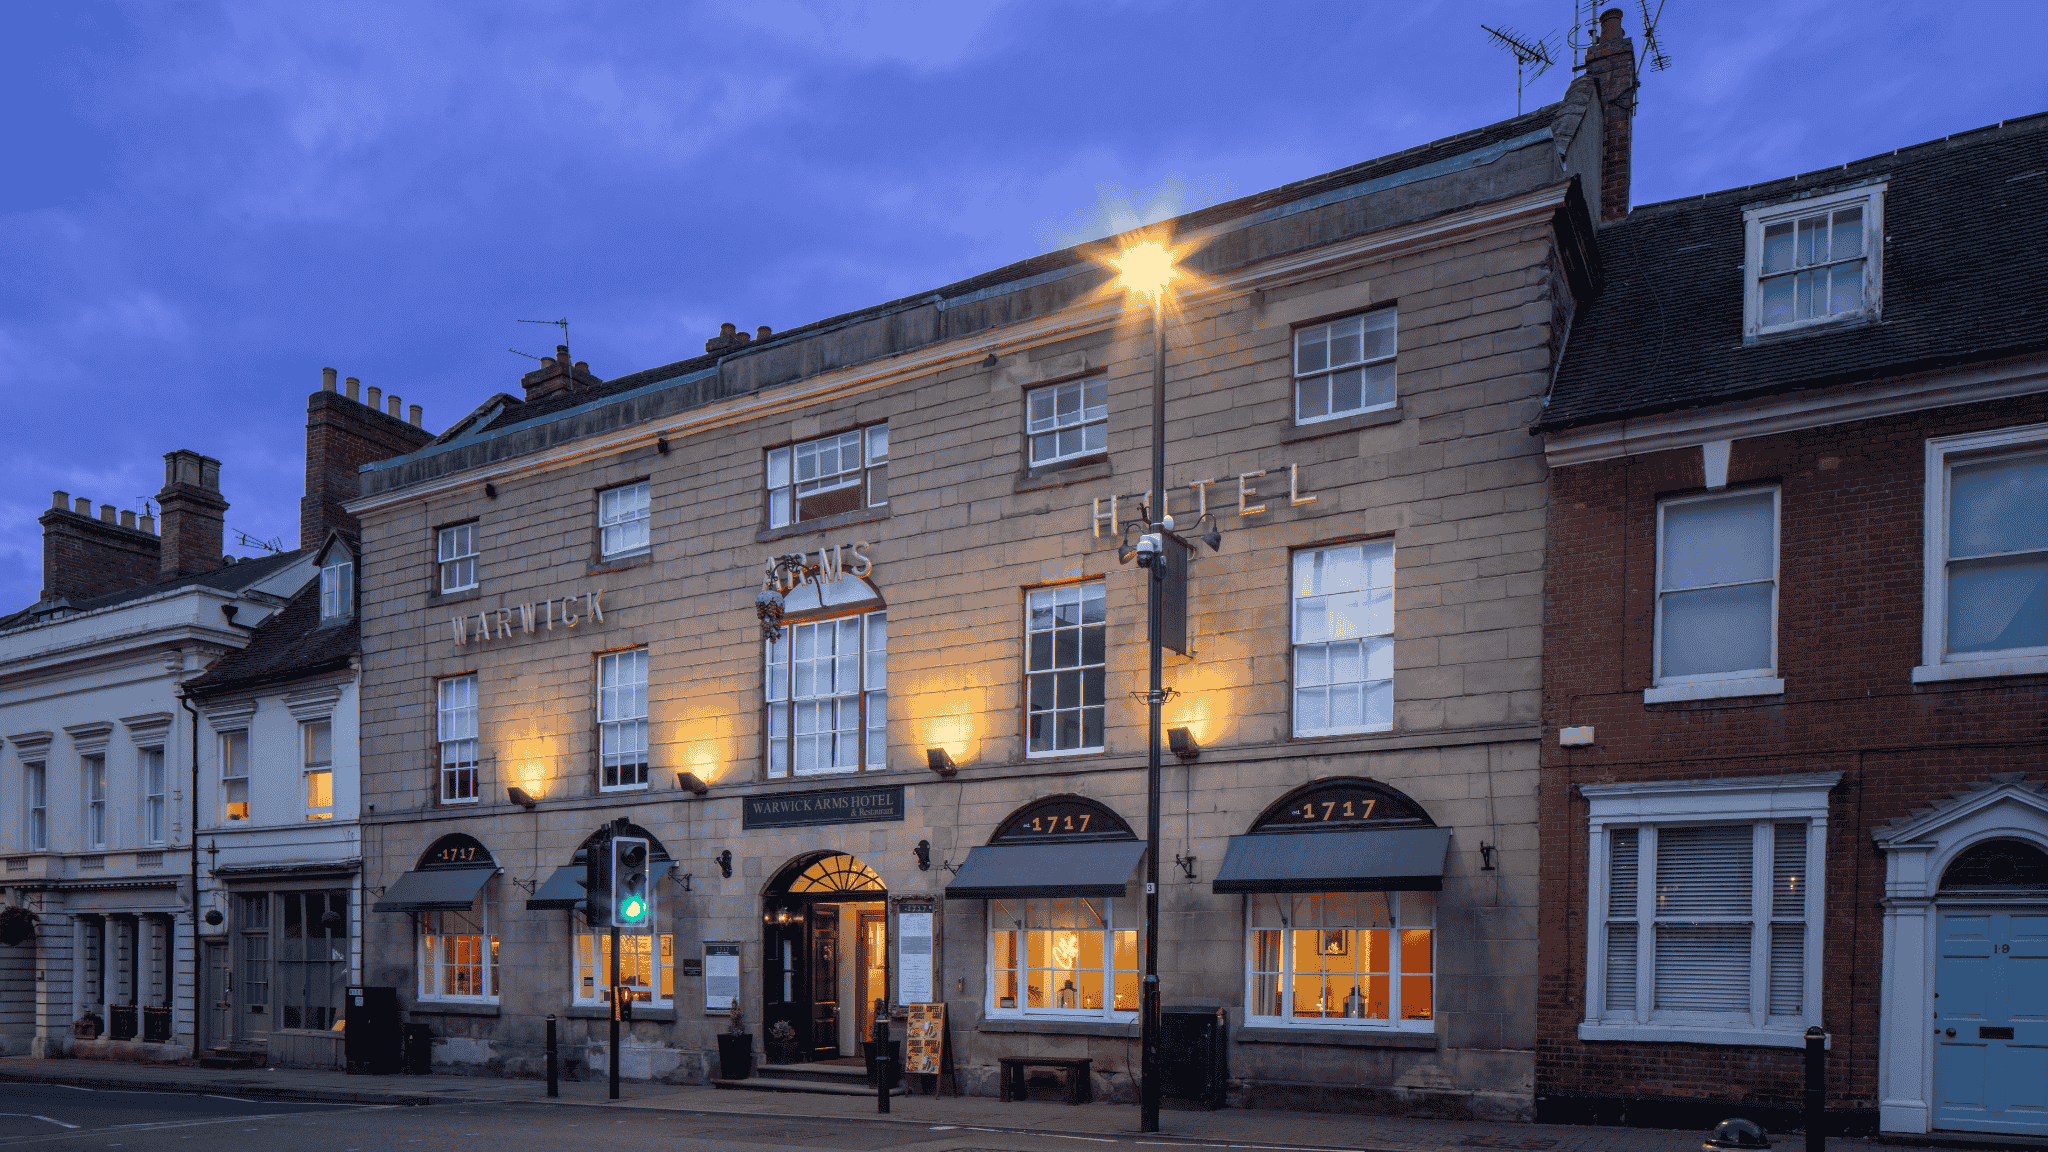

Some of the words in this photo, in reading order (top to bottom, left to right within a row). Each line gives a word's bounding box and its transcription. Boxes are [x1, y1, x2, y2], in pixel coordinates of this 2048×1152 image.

[451, 588, 604, 646] WARWICK
[761, 540, 873, 592] ARMS
[752, 799, 812, 814] WARWICK
[813, 796, 849, 810] ARMS
[850, 793, 894, 808] HOTEL
[850, 808, 858, 817] &
[859, 807, 894, 816] Restaurant
[1303, 799, 1376, 821] 1717
[1032, 814, 1091, 834] 1717
[443, 847, 476, 861] 1717
